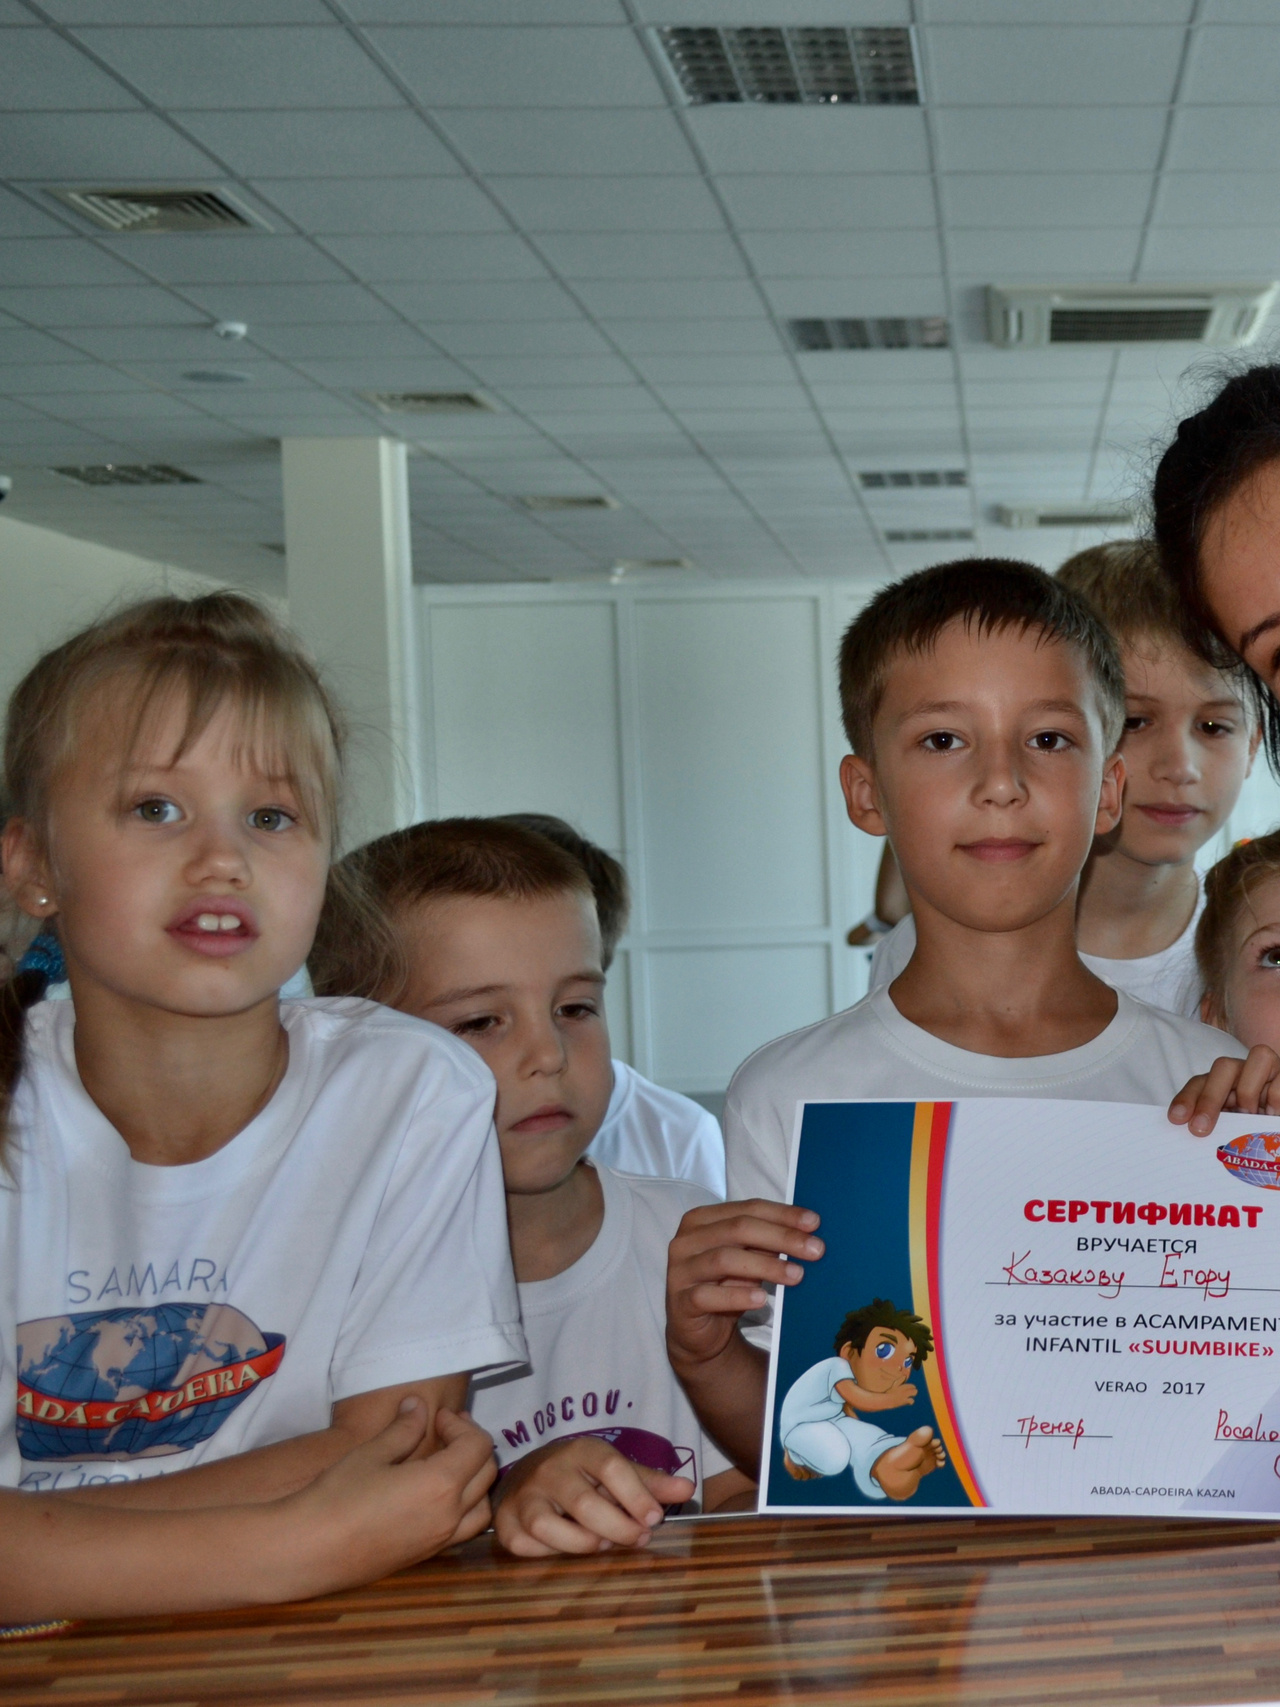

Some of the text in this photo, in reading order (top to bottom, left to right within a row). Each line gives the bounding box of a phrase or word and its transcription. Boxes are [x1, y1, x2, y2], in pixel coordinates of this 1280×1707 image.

[1023, 1199, 1264, 1228] СЕРТИФИКАТ
[1076, 1237, 1198, 1254] ВРУЧАЕТСЯ
[1003, 1249, 1231, 1302] Казакову Егору
[994, 1314, 1018, 1327] за
[1024, 1314, 1109, 1330] участие
[1115, 1317, 1127, 1328] в
[1025, 1337, 1274, 1358] INFANTIL «SUUMBIKE»
[1094, 1381, 1206, 1395] VERAO 2017
[1090, 1485, 1236, 1499] ABADA-CAPOEIRA KAZAN
